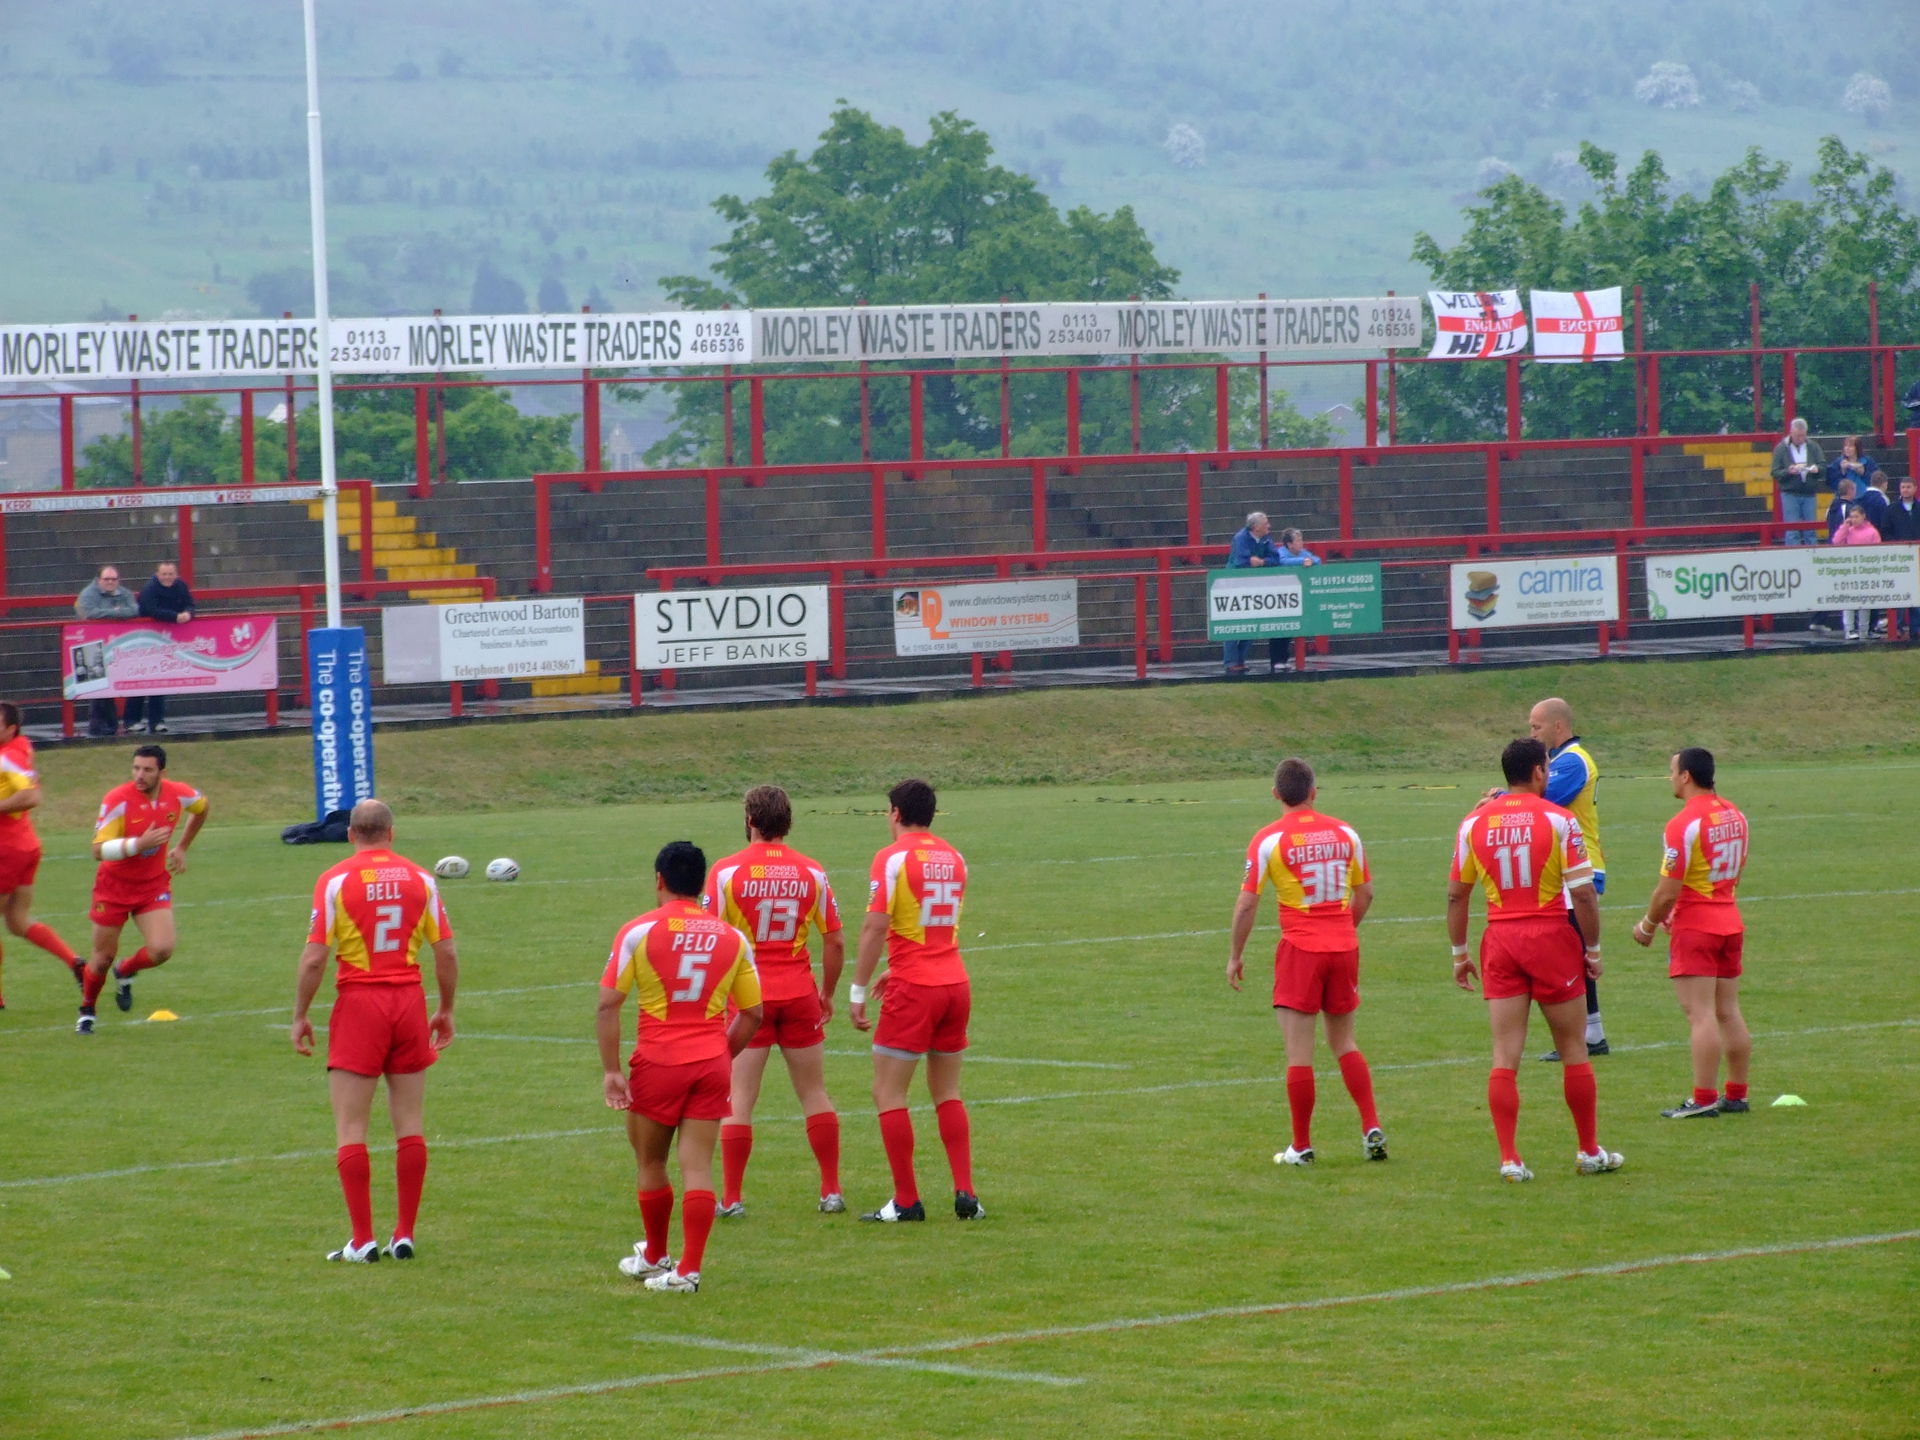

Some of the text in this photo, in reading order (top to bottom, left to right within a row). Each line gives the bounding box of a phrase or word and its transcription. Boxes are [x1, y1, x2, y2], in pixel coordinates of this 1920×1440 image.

[1062, 313, 1097, 328] 0113
[1371, 308, 1412, 322] 01924
[696, 323, 739, 338] 01924
[761, 311, 1042, 357] MORLEY WASTE TRADERS
[1048, 328, 1111, 344] 2534007
[1118, 306, 1360, 348] MORLEY WASTE TRADERS
[1368, 322, 1416, 337] 466536
[347, 331, 386, 344] 0113
[409, 320, 681, 366] MORLEY WASTE TRADERS
[690, 338, 744, 353] 466536
[2, 327, 319, 375] MORLEY WASTE TRADERS
[331, 347, 400, 361] 2534007
[5, 500, 32, 511] KERR
[117, 495, 144, 507] KERR
[226, 490, 252, 502] KERR
[1519, 560, 1604, 595] camira
[1655, 568, 1673, 579] The
[1214, 593, 1299, 612] WATSONS
[1731, 591, 1786, 603] working together
[445, 604, 580, 624] Greenwood Barton
[657, 593, 806, 633] STVDIO
[949, 613, 1049, 628] WINDOW SYSTEMS
[1214, 621, 1301, 634] PROPERTY SERVICES
[659, 642, 807, 664] JEFF BANKS
[317, 650, 337, 685] The
[348, 648, 364, 684] The
[454, 665, 505, 678] Telephone
[507, 661, 538, 673] 01924
[1486, 826, 1532, 847] ELIMA
[1708, 820, 1744, 843] BENTLEY
[1287, 841, 1351, 865] SHERWIN
[1708, 839, 1743, 884] 20
[923, 863, 955, 880] GIGOT
[1494, 844, 1532, 890] 11
[366, 882, 402, 902] BELL
[741, 880, 808, 898] JOHNSON
[1300, 859, 1347, 905] 30
[918, 881, 962, 927] 25
[373, 905, 403, 953] 2
[755, 898, 800, 943] 13
[671, 933, 718, 952] PELO
[671, 953, 712, 1002] 5
